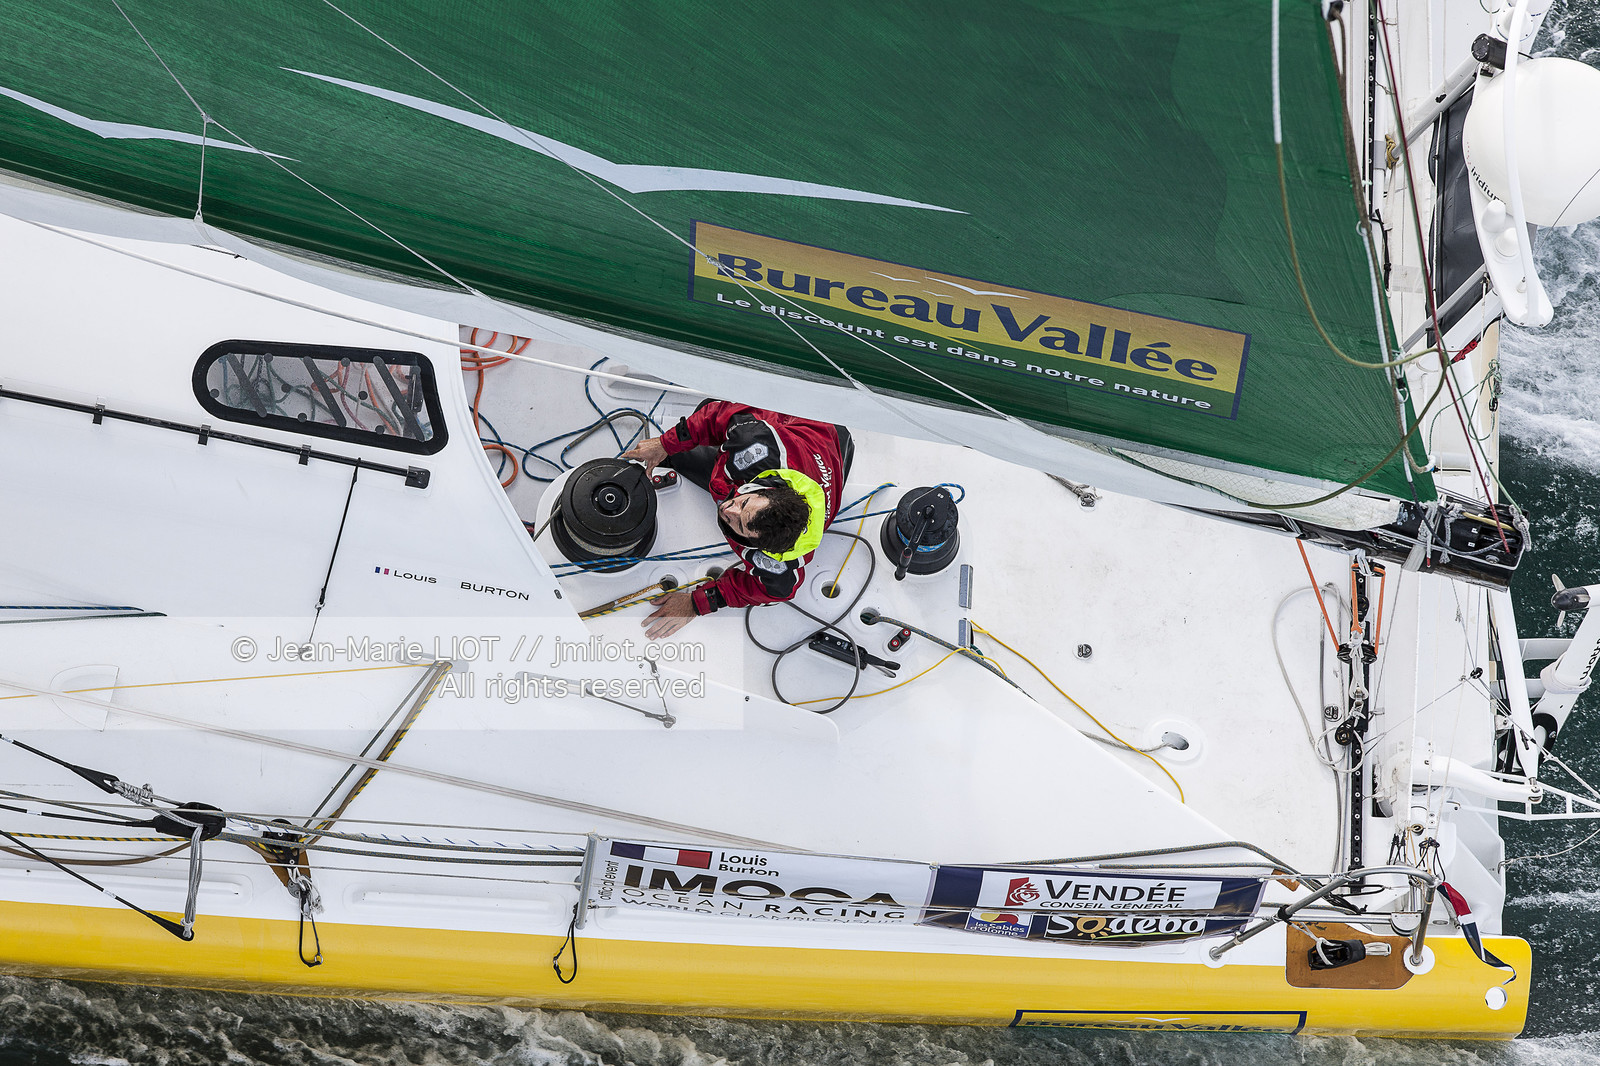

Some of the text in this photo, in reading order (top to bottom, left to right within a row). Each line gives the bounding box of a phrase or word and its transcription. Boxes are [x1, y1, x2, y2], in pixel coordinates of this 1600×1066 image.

[716, 252, 1218, 381] Bureau Vallée
[716, 292, 1213, 409] Le discount est dans notre nature
[393, 570, 530, 601] LOUIS BURTON
[718, 864, 780, 877] Burton
[719, 852, 768, 867] Louis
[624, 864, 907, 909] IMOCA
[1045, 879, 1187, 902] VENDÉE
[621, 897, 712, 914] WORLD
[622, 888, 905, 919] OCEAN RACING
[1039, 901, 1104, 909] CONSEIL
[989, 923, 1025, 933] Sables
